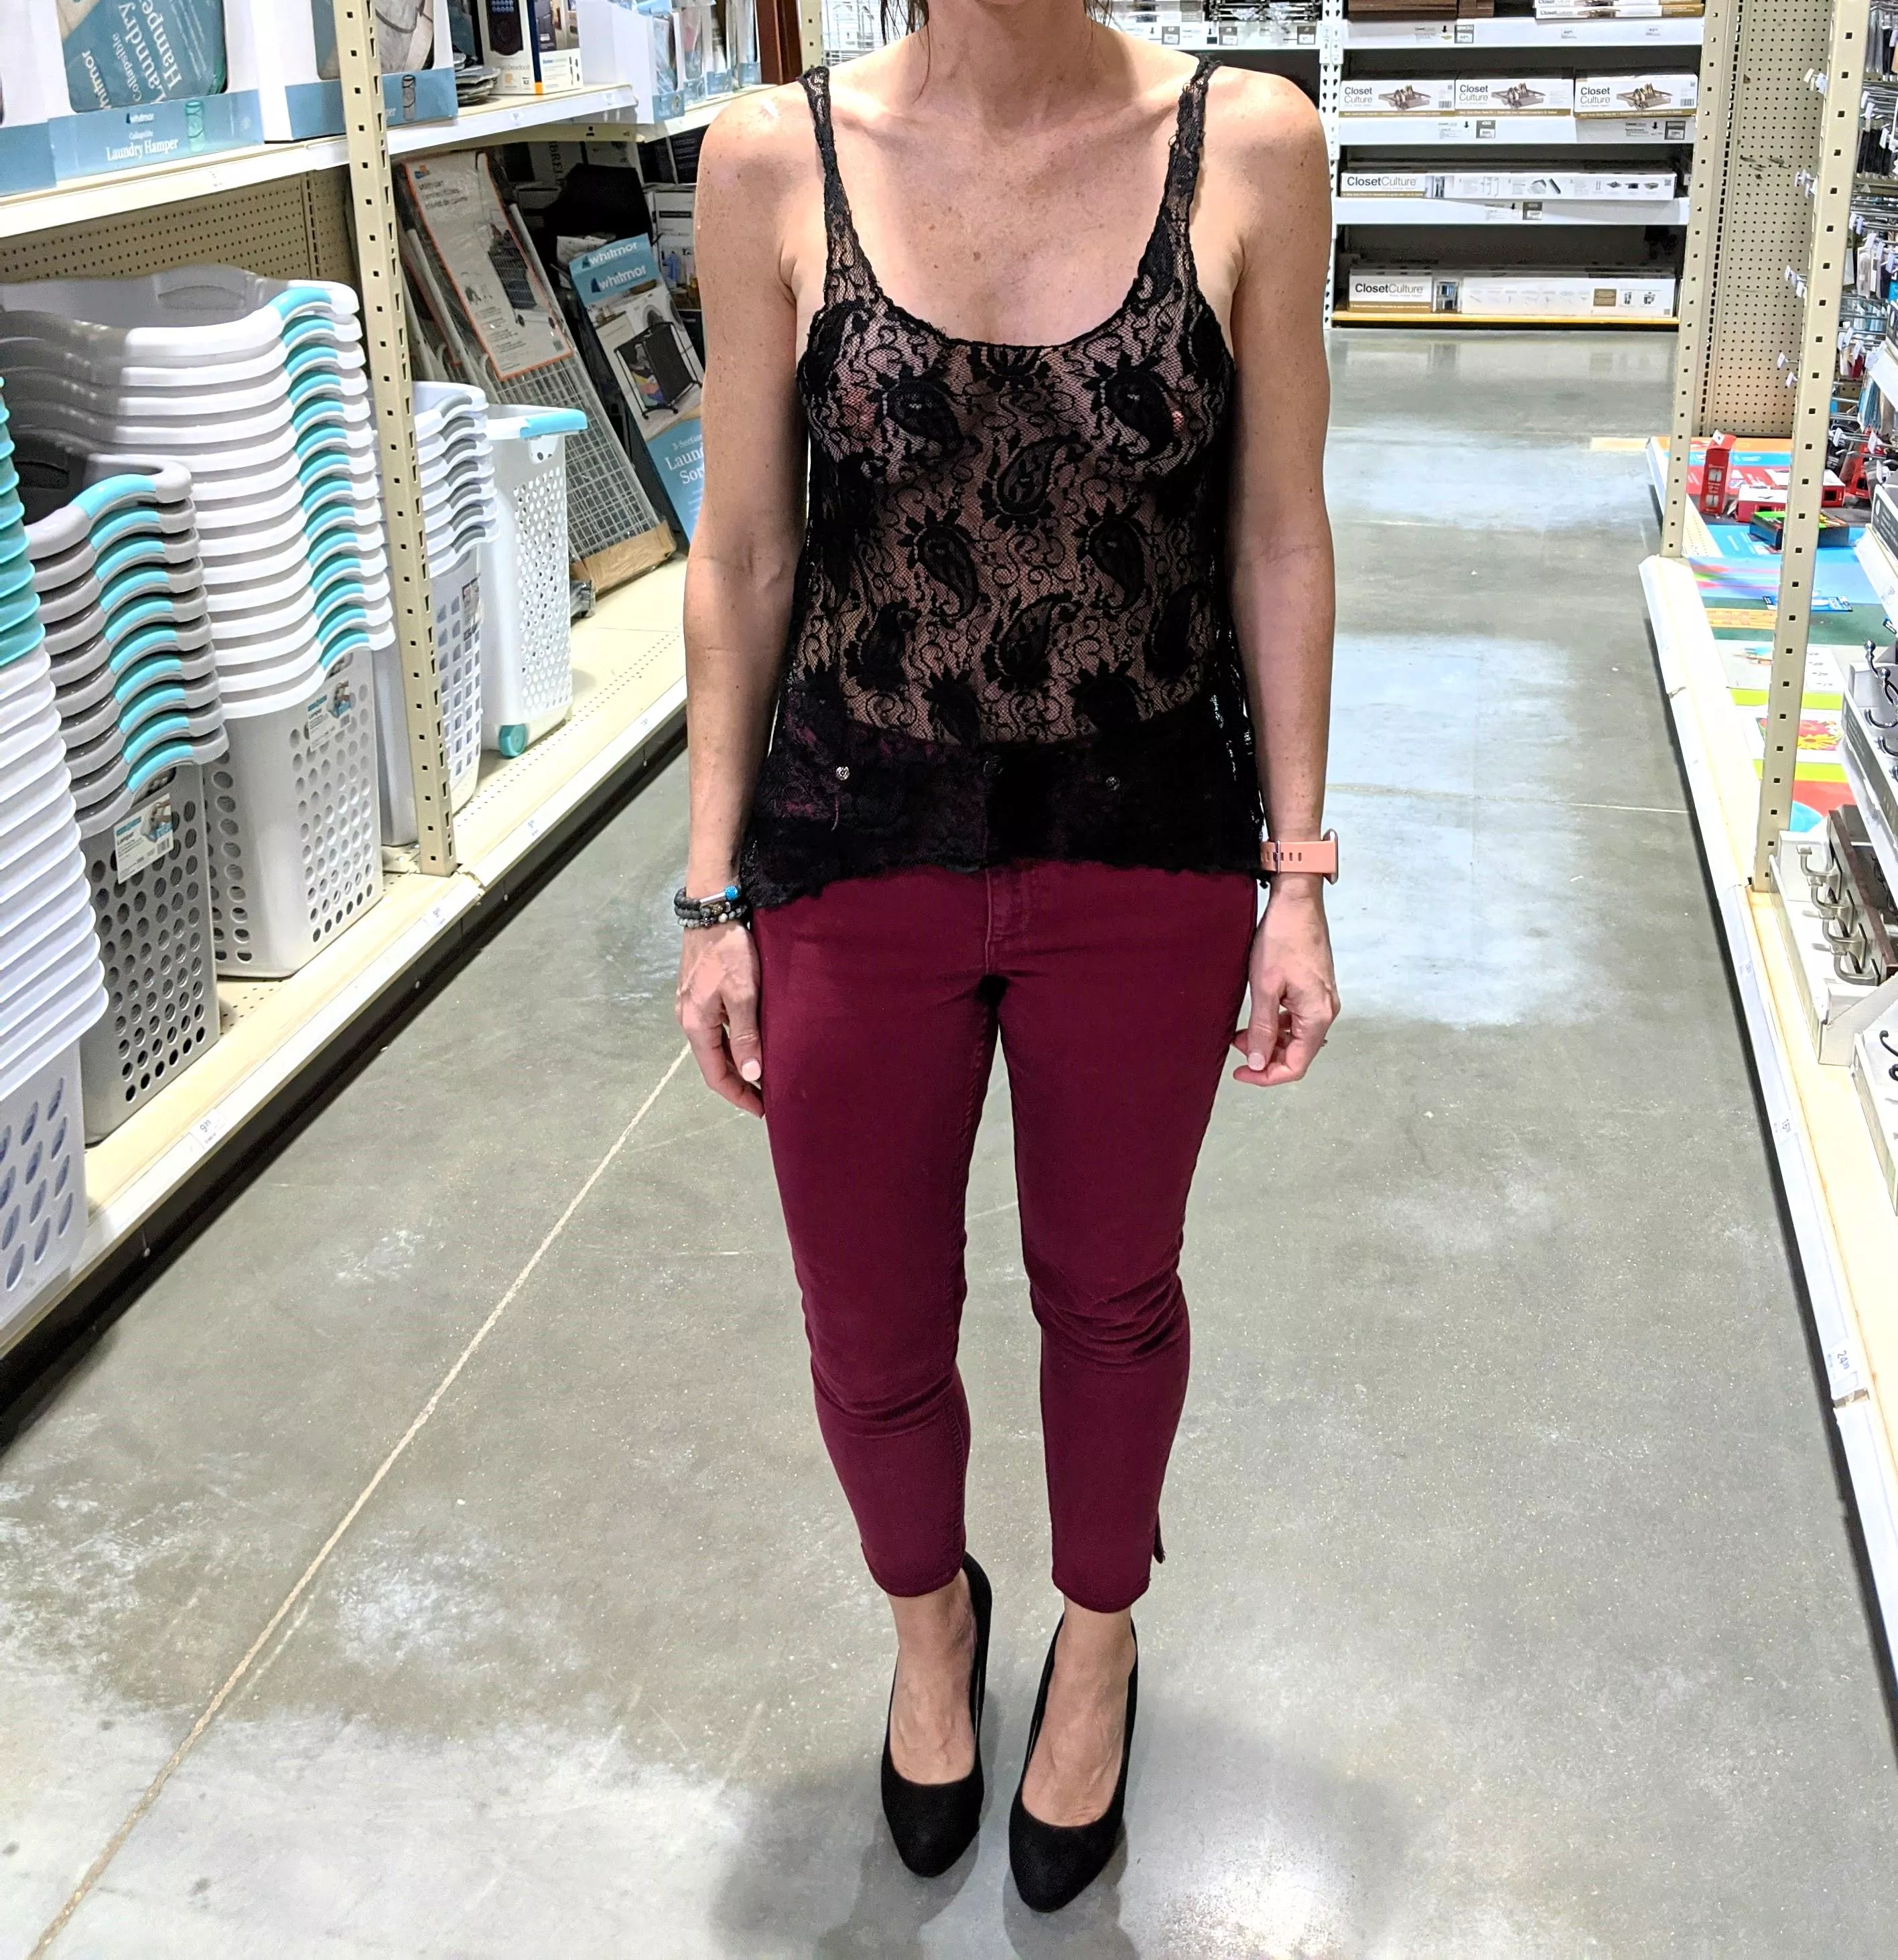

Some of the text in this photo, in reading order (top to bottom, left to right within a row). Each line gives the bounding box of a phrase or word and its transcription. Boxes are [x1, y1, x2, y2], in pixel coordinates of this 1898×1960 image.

[139, 0, 183, 90] Hampe
[119, 2, 167, 105] Laundry
[112, 33, 142, 102] Collapsible
[1344, 86, 1373, 95] Closet
[1459, 84, 1489, 92] Closet
[1580, 86, 1611, 95] Closet
[1344, 95, 1373, 103] Culture
[1459, 92, 1489, 101] Culture
[1580, 95, 1611, 104] Culture
[106, 139, 179, 161] Laundry Hamper
[1347, 176, 1417, 187] ClosetCulture
[589, 242, 637, 265] whitmor
[598, 265, 647, 290] whitmor
[1355, 283, 1424, 294] ClosetCulture
[665, 441, 705, 470] Laund
[679, 466, 705, 485] Sor
